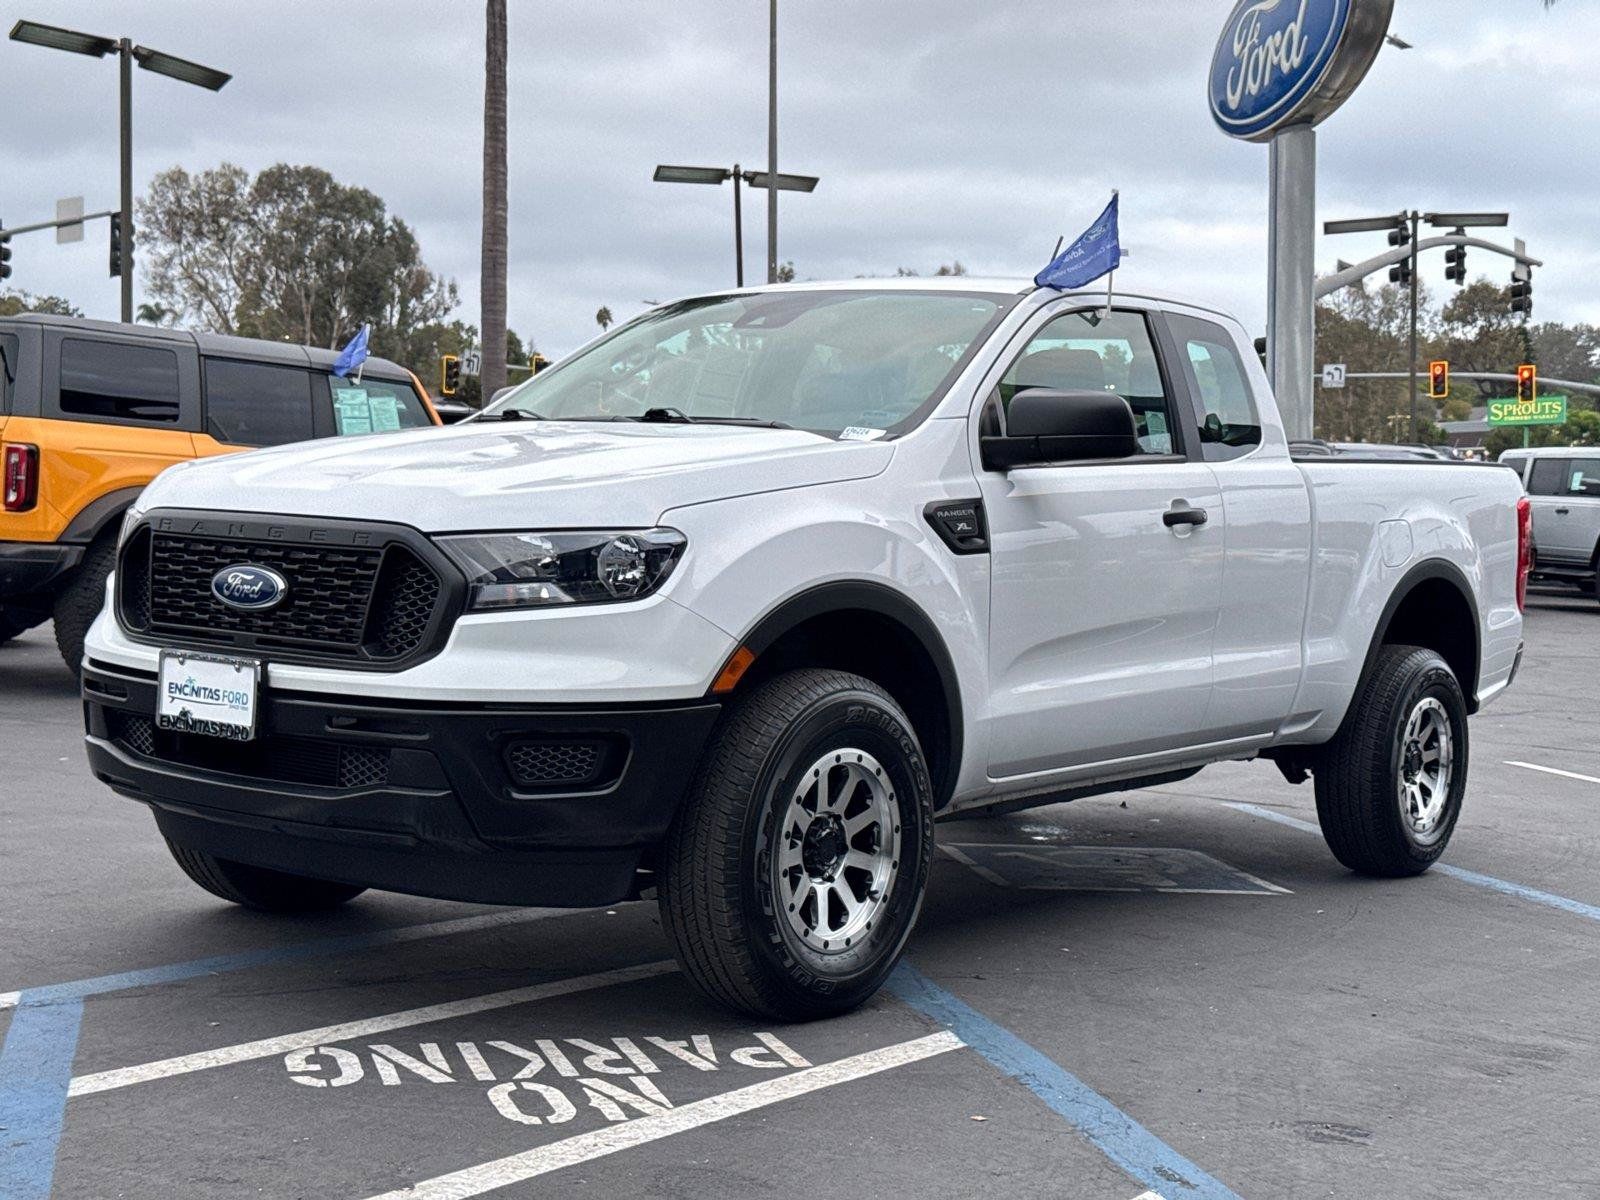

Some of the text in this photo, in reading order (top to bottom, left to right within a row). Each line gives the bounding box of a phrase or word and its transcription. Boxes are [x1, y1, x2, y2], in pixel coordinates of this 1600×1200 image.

[1226, 0, 1308, 110] Ford
[1490, 401, 1562, 420] SPROUTS
[936, 508, 976, 518] RANGER
[956, 522, 972, 531] XL
[158, 518, 372, 546] RANGER
[223, 571, 263, 599] Ford
[168, 678, 249, 706] ENCINITAS FORD
[160, 714, 250, 741] ENCINITAS FORD
[284, 1032, 813, 1088] PARKING
[486, 1075, 674, 1125] NO
